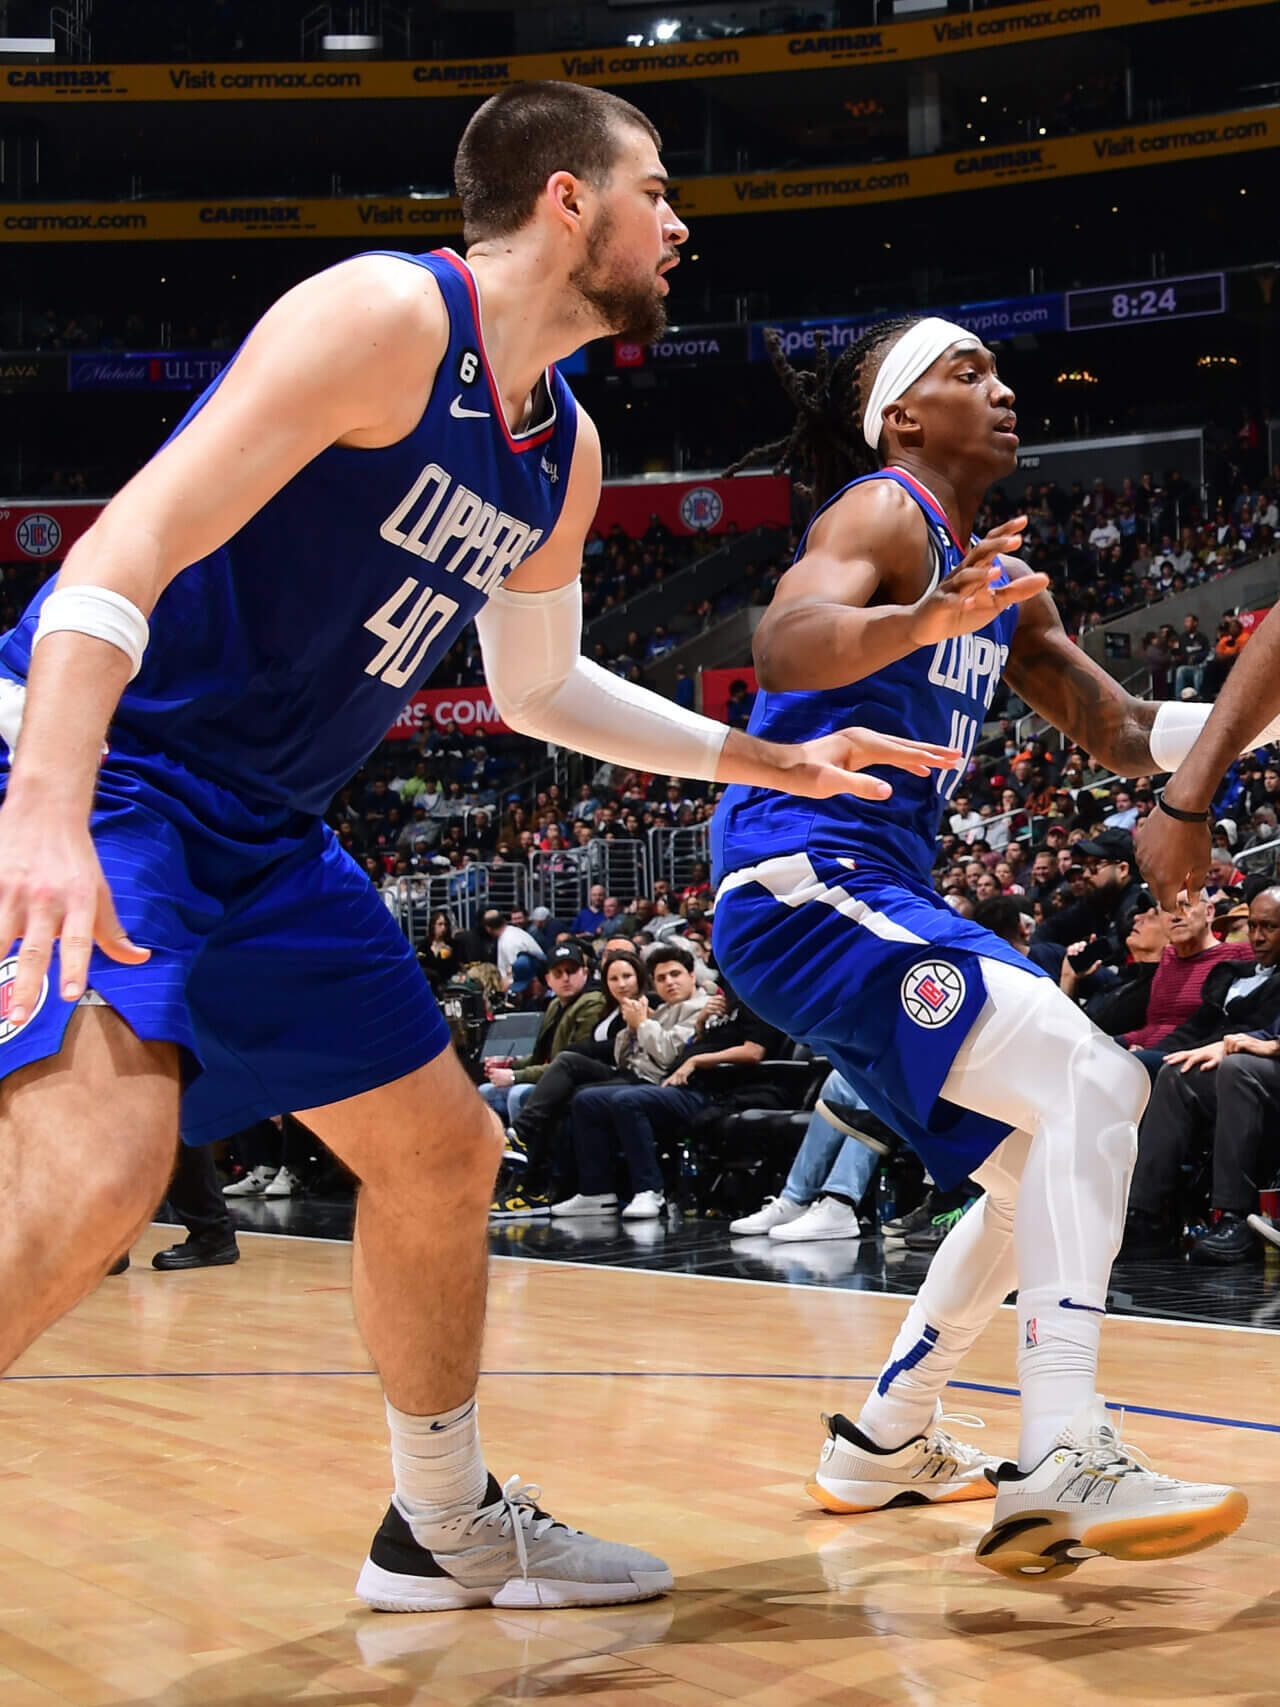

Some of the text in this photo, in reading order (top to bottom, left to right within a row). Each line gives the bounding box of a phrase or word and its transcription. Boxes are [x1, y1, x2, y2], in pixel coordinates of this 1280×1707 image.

[934, 4, 1100, 42] Visit carmax.com
[562, 49, 739, 76] Visit carmax.com
[170, 70, 360, 88] Visit carmax.com
[1093, 121, 1268, 158] Visit carmax.com
[734, 172, 910, 202] Visit carmax.com
[4, 213, 146, 230] carmax.com
[358, 205, 404, 223] Visit
[1111, 287, 1176, 319] 8:24
[652, 340, 721, 358] TOYOTA
[774, 326, 868, 356] Spectru
[165, 360, 223, 379] ULTR
[460, 353, 478, 383] 6
[363, 576, 459, 688] 40
